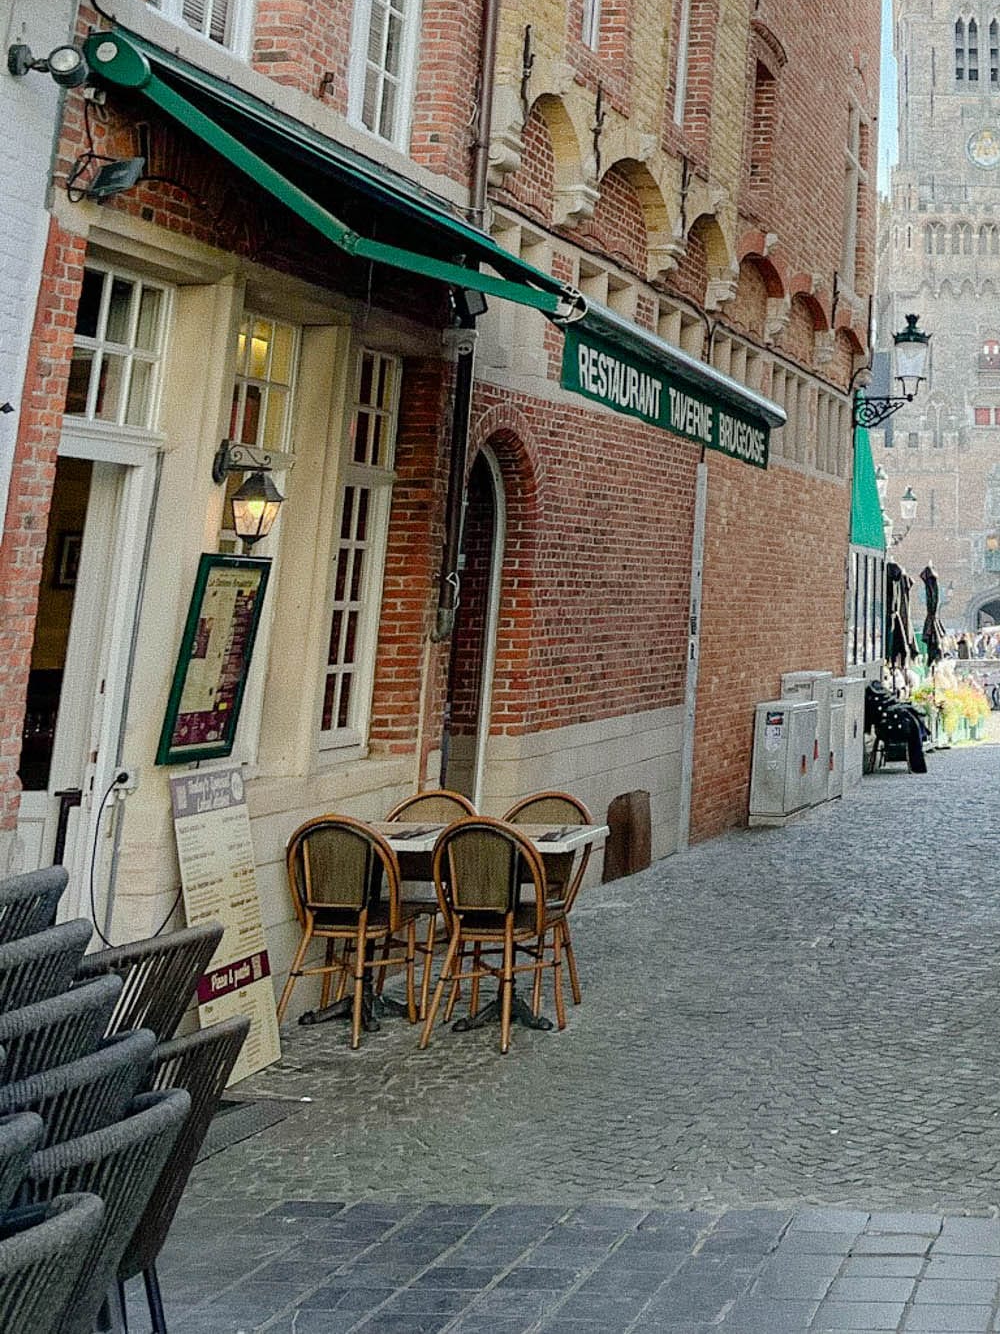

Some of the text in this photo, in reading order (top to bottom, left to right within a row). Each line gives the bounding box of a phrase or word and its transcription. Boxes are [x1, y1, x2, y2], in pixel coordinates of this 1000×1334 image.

[577, 343, 766, 464] RESTAURANT TAVERNE BRUGEOISE
